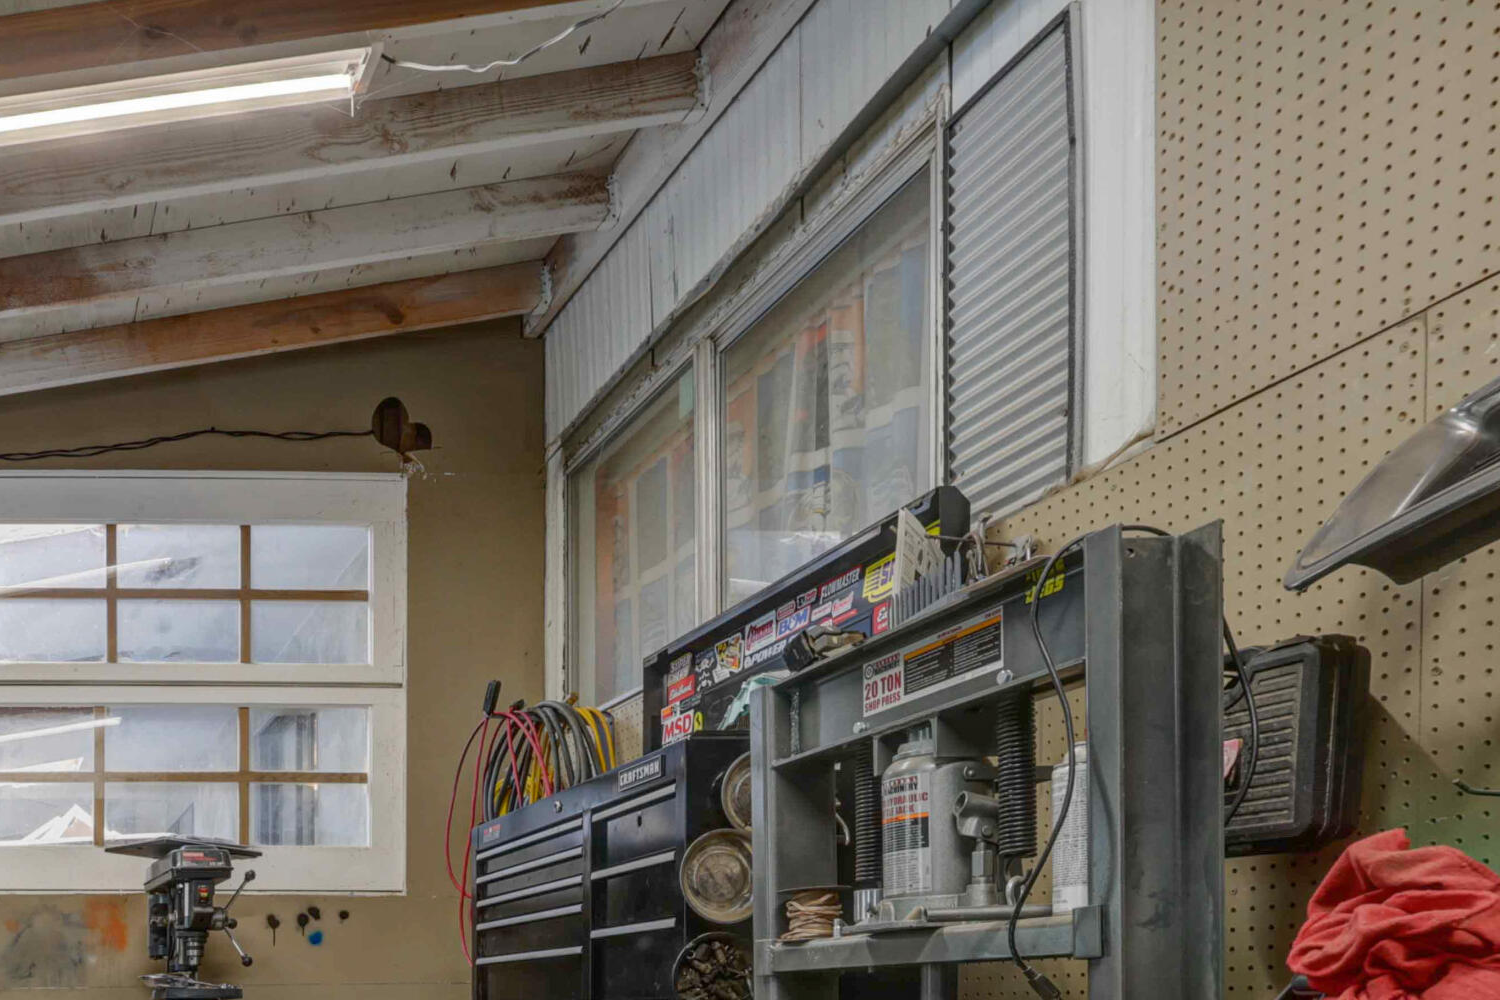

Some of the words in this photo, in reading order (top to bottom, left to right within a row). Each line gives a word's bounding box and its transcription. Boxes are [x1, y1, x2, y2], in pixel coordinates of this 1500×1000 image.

[820, 567, 861, 604] FLOWMASTER
[1024, 573, 1066, 604] JGS
[865, 680, 878, 701] 20
[881, 671, 902, 695] TON
[865, 700, 880, 713] SHOP
[882, 691, 901, 708] PRESS
[662, 713, 692, 744] MSD
[620, 760, 660, 786] CRAFTSMAN
